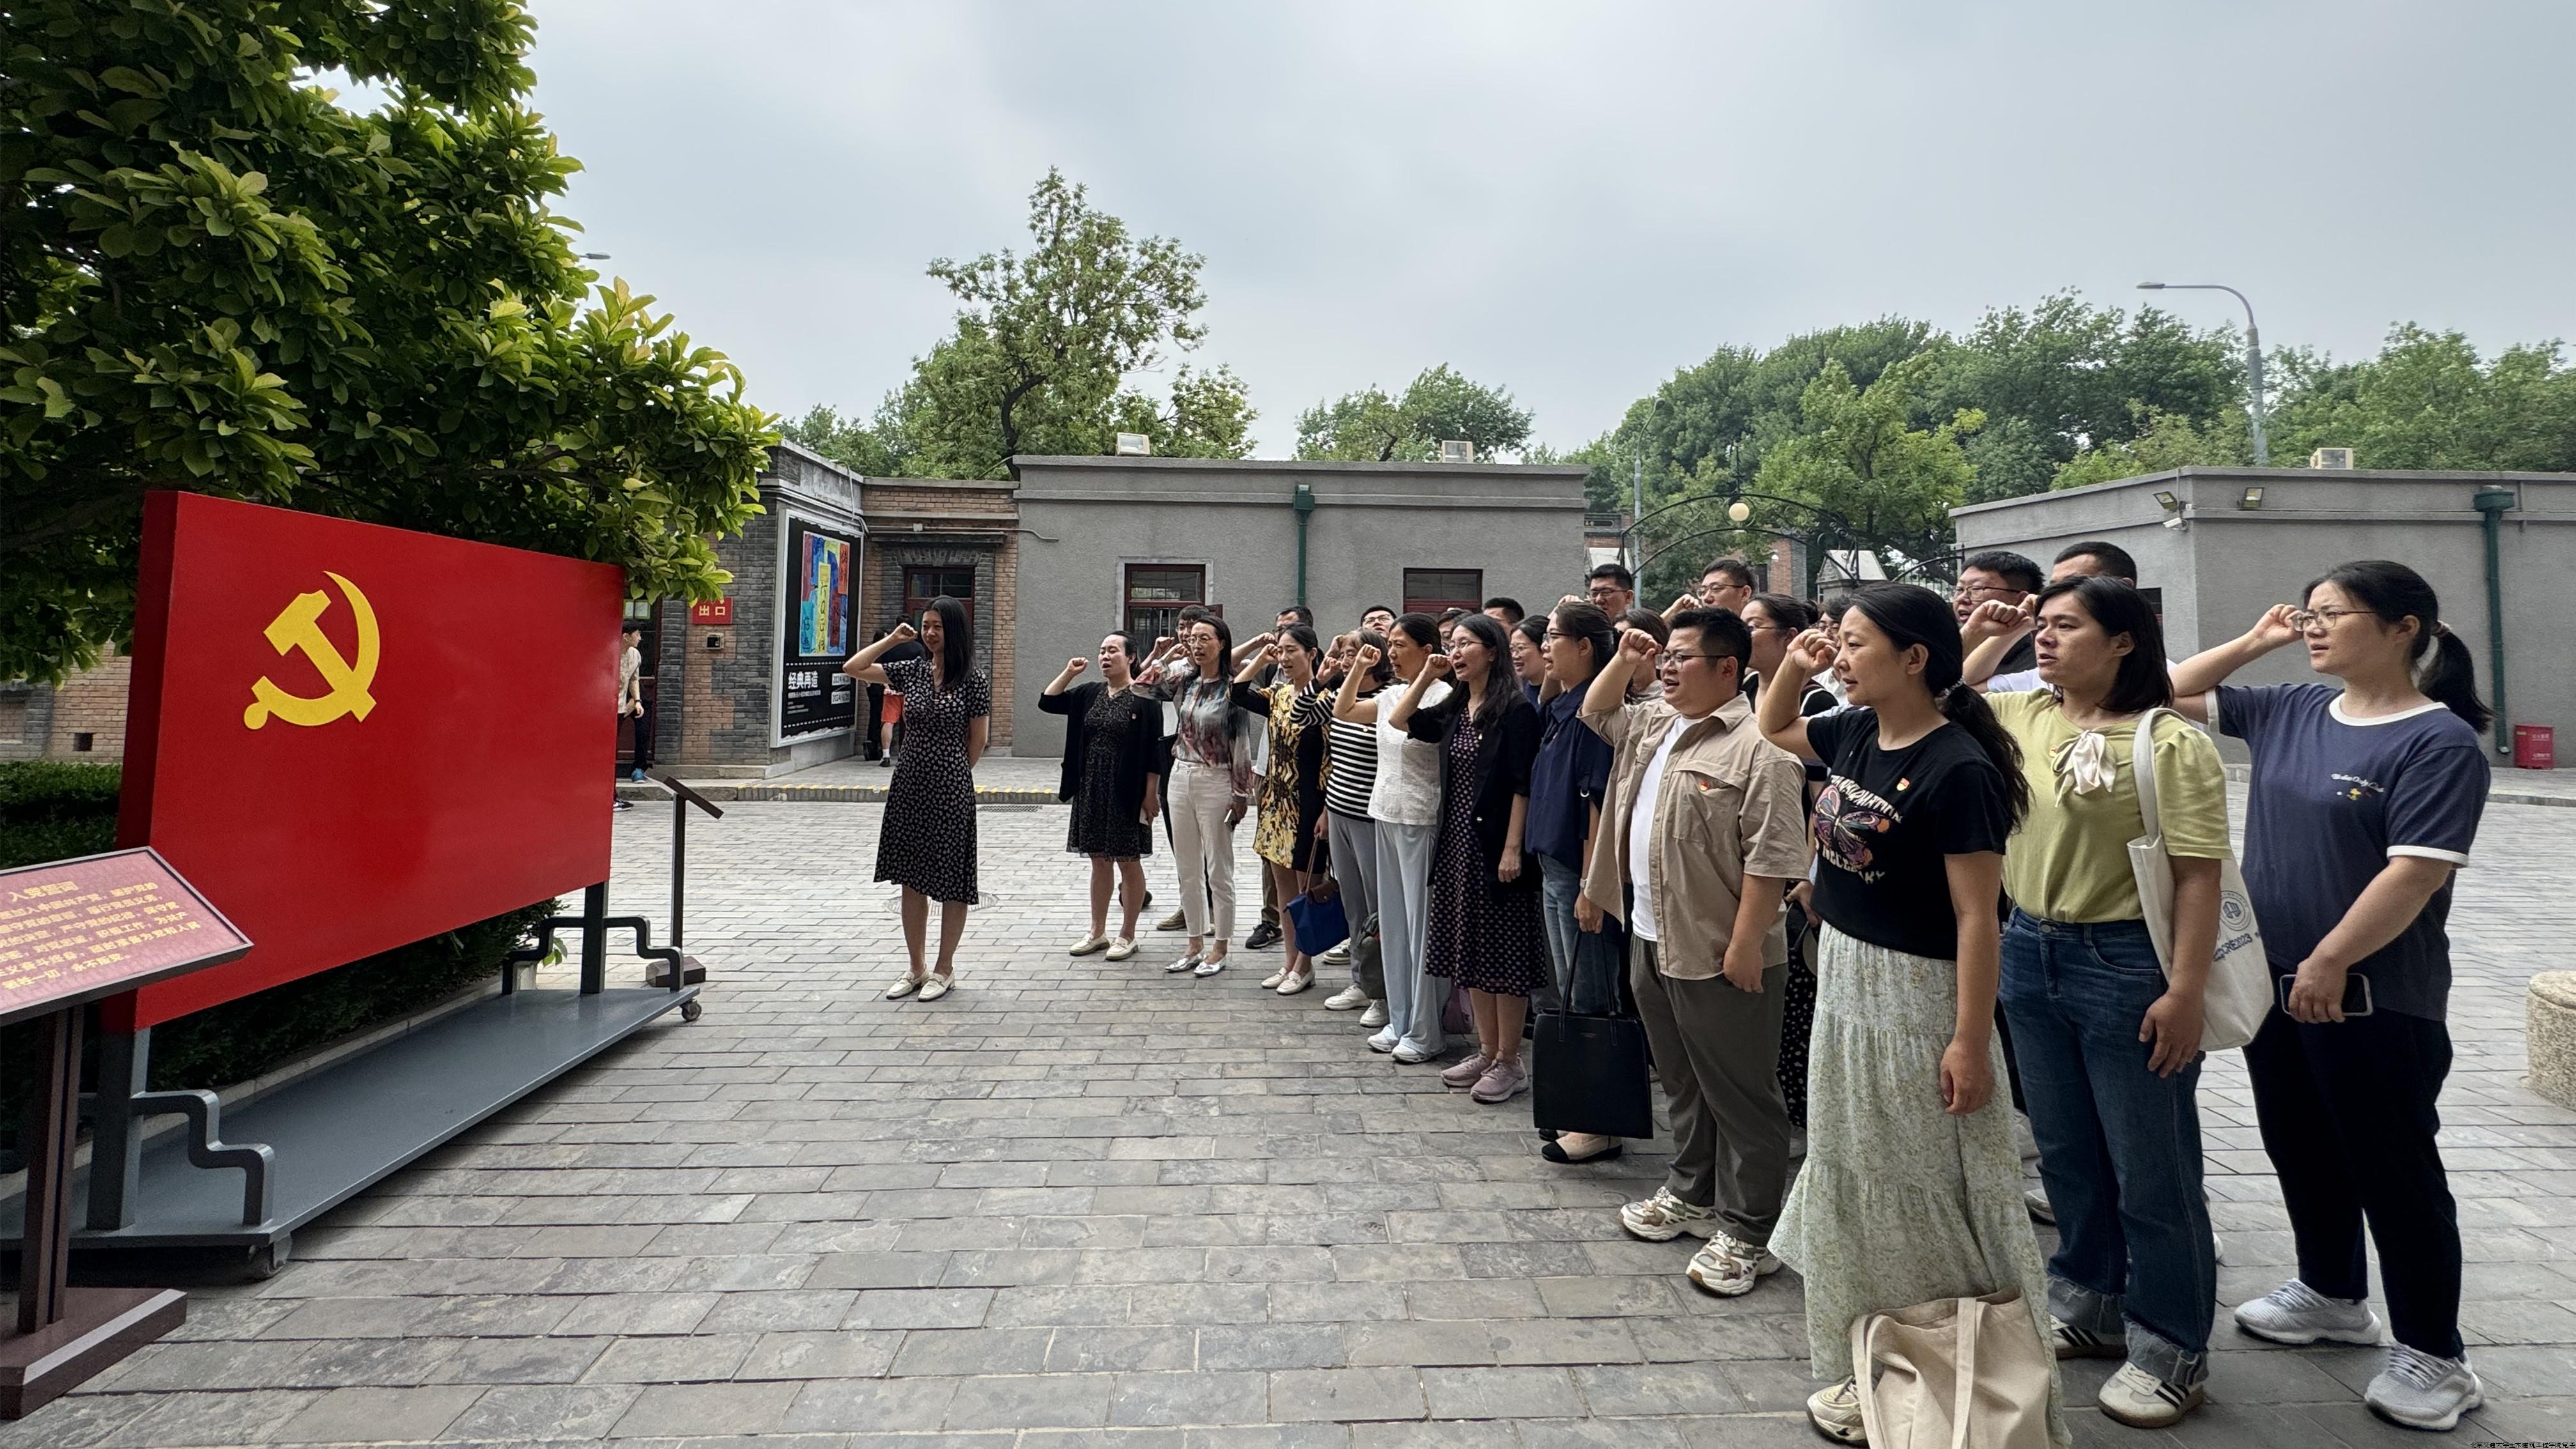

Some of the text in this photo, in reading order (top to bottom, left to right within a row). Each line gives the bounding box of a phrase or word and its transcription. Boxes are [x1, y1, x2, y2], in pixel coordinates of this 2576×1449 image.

[698, 604, 726, 617] 出口
[788, 670, 819, 690] 经典再造
